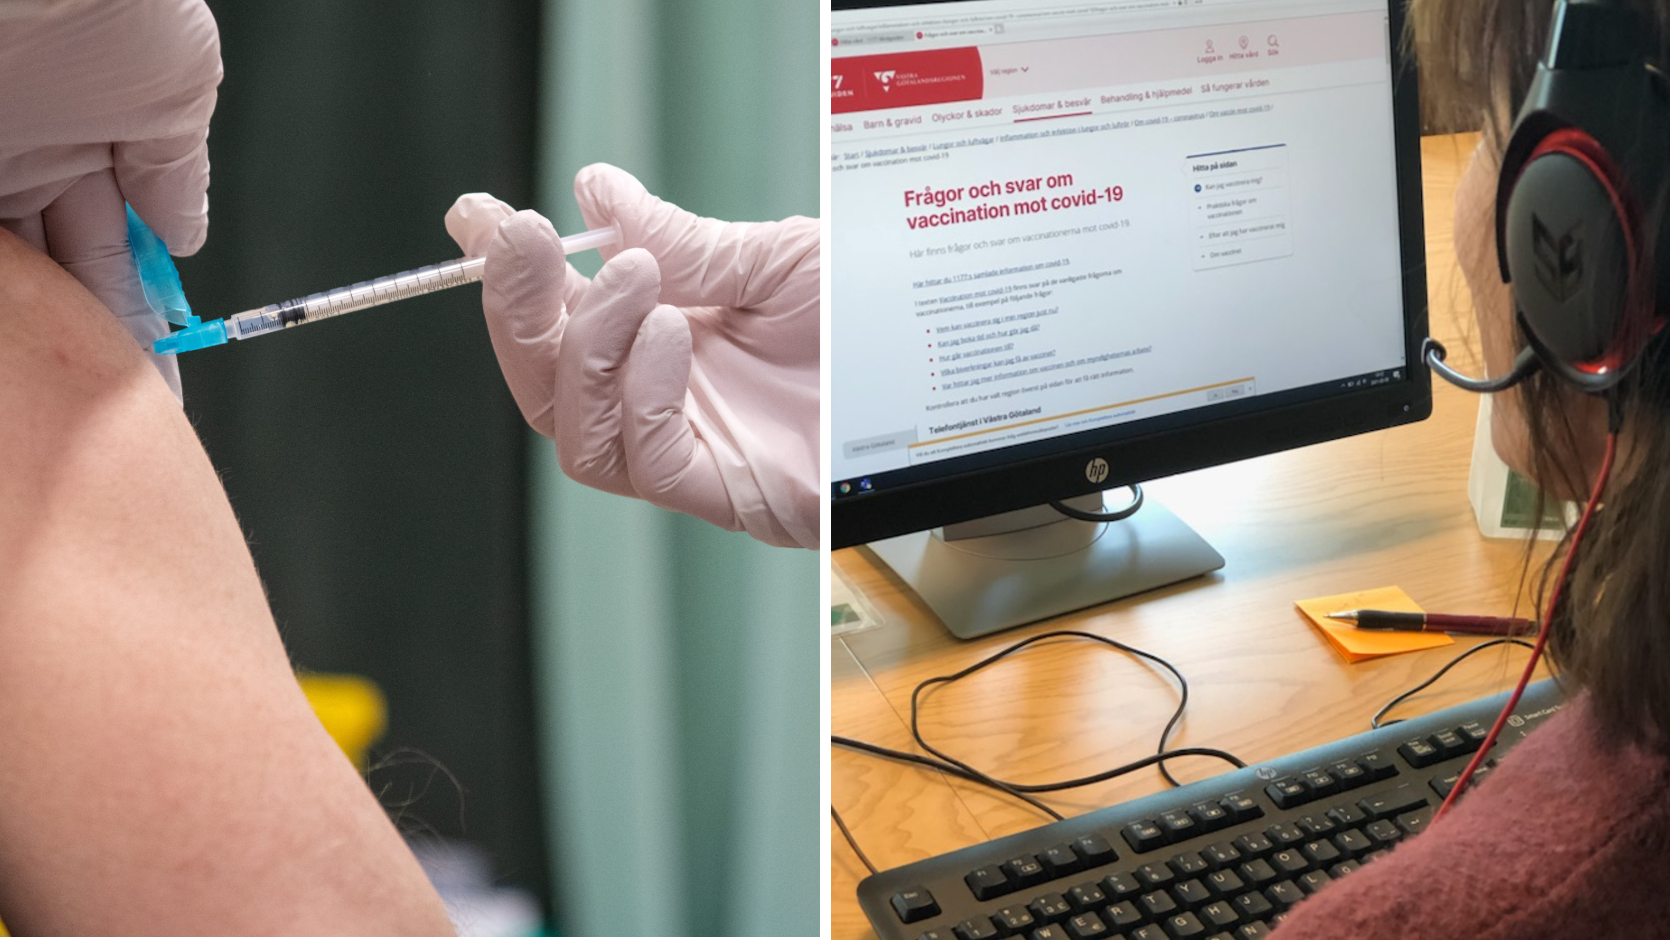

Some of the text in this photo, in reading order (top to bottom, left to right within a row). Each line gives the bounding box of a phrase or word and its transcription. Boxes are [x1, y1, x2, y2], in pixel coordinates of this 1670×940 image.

[1201, 83, 1210, 93] Så
[1212, 82, 1242, 92] fungerar
[1100, 91, 1143, 104] Behandling
[1152, 87, 1192, 100] hjälpmedel
[1012, 98, 1092, 114] Sjukdomar & besvär
[932, 108, 1002, 123] Olyckor & skador
[864, 115, 922, 130] Barn & gravid
[1210, 162, 1218, 171] på
[1220, 160, 1238, 168] sidan
[904, 174, 1073, 208] Frågor och svar om
[907, 185, 1124, 230] vaccination mot covid-19
[910, 249, 924, 260] Här
[926, 246, 946, 257] finns
[948, 241, 972, 254] frågor
[974, 240, 989, 250] och
[990, 237, 1006, 247] svar
[1008, 235, 1021, 245] om
[1022, 228, 1082, 243] vaccinationerna
[1082, 224, 1098, 234] mot
[926, 400, 960, 411] Kontrollera
[929, 406, 1042, 434] Telefontjänst i Västra Götaland
[1087, 458, 1108, 483] hp
[1310, 843, 1318, 851] P
[1214, 874, 1225, 882] U
[1306, 874, 1318, 884] L
[1180, 884, 1189, 892] Y
[1274, 884, 1286, 893] K
[1146, 895, 1156, 904] T
[1111, 907, 1123, 916] R
[1208, 906, 1221, 916] H
[1075, 917, 1086, 926] E
[1175, 917, 1187, 926] G
[1040, 928, 1051, 938] W
[1138, 930, 1148, 938] F
[1244, 926, 1258, 935] N
